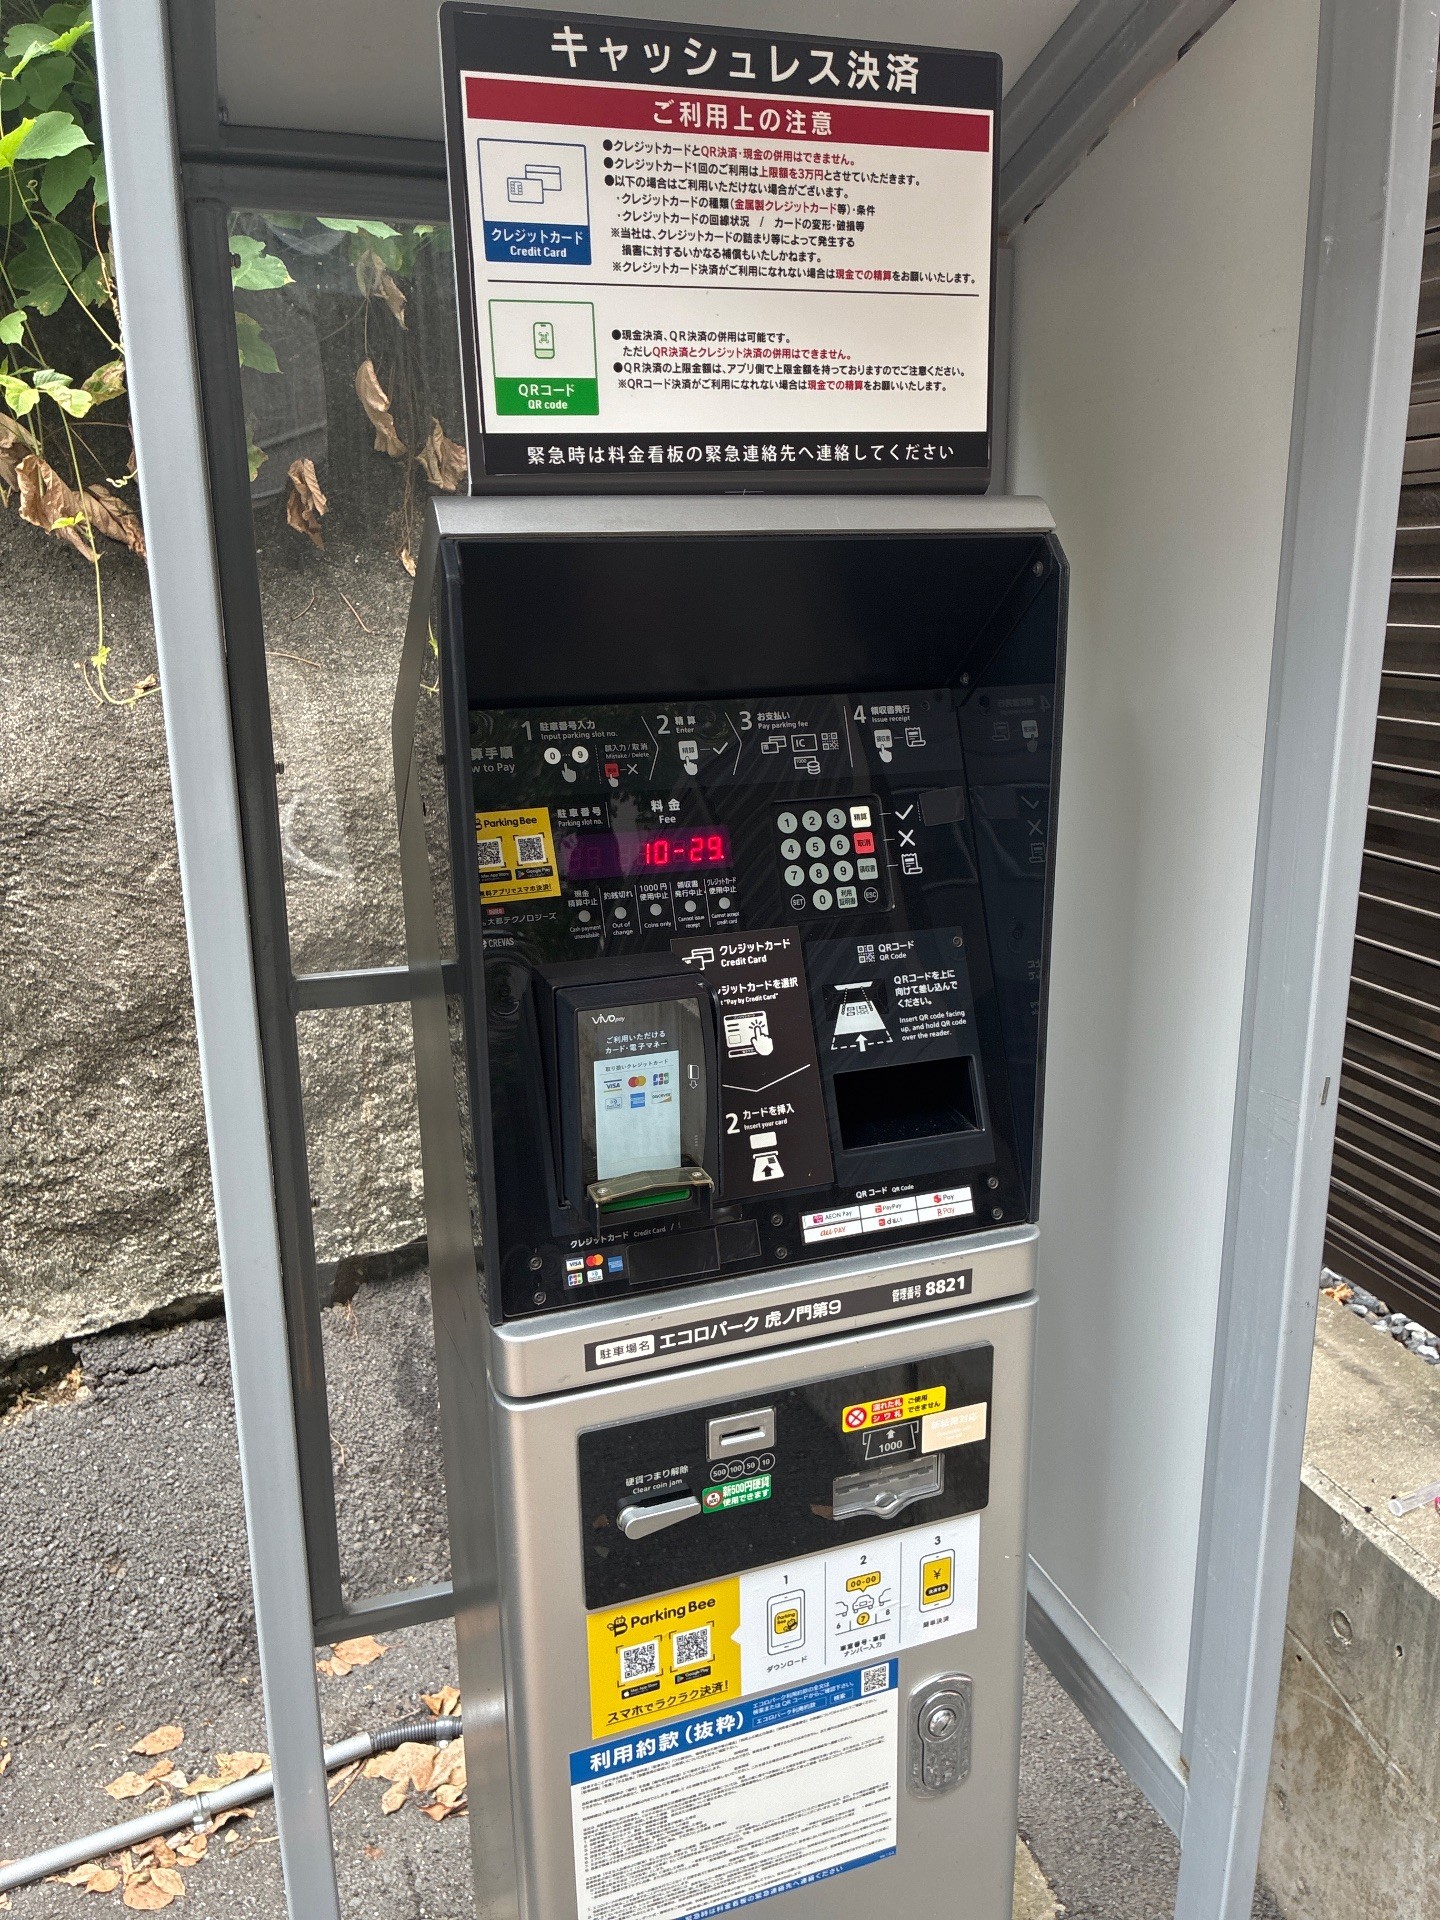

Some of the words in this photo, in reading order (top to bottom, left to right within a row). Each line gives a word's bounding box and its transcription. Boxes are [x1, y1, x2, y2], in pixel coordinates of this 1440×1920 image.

[551, 25, 920, 95] キャッシュレス決済
[653, 99, 833, 137] ご利用上の注意
[614, 174, 849, 199] 以下の場合はご利用いただけない場合がございます。
[774, 217, 866, 233] カードの変形・破損等
[490, 226, 584, 247] クレジットカード
[510, 246, 541, 259] Credit
[543, 247, 567, 260] Card
[622, 243, 822, 263] 損害に対するいかなる補償もいたしかねます。
[518, 383, 576, 398] QRコード
[528, 399, 542, 412] QR
[544, 399, 569, 411] code
[527, 443, 955, 466] 緊急時は料金看板の緊急連絡先へ連絡してください
[674, 715, 697, 726] 精算
[739, 710, 753, 731] 3
[757, 711, 791, 722] お支払い
[853, 704, 867, 724] 4
[521, 720, 532, 741] 1
[539, 720, 596, 732] 駐車番号入力
[656, 714, 671, 735] 2
[675, 726, 695, 735] Enter
[758, 722, 770, 730] Pay
[771, 721, 796, 730] parking
[798, 720, 809, 728] fee
[541, 733, 562, 741] Input
[563, 731, 589, 741] parking
[591, 730, 604, 738] slot
[796, 738, 806, 748] IC
[483, 764, 495, 773] to
[497, 763, 516, 774] Pay
[557, 807, 602, 819] 駐車番号
[651, 798, 681, 813] 料金
[483, 818, 519, 828] Parking
[519, 816, 538, 826] Bee
[558, 820, 581, 828] Parking
[659, 815, 677, 824] Fee
[784, 818, 790, 828] 1
[809, 816, 816, 826] 2
[833, 814, 840, 823] 3
[853, 812, 868, 821] 精算
[787, 844, 794, 854] 4
[812, 842, 819, 852] 5
[836, 840, 844, 850] 6
[790, 870, 798, 881] 7
[815, 868, 823, 879] 8
[840, 865, 847, 876] 9
[573, 889, 590, 899] 現金
[819, 894, 826, 905] 0
[581, 924, 601, 932] payment
[613, 928, 634, 936] change
[644, 921, 656, 929] Coins
[657, 920, 672, 928] only
[488, 937, 515, 948] CREVAS
[719, 938, 791, 956] クレジットカード
[878, 940, 915, 953] QRコード
[720, 957, 747, 968] Credit
[747, 955, 767, 965] Card
[879, 954, 889, 962] QR
[890, 952, 907, 960] Code
[893, 969, 956, 985] QRコードを上に
[894, 981, 958, 997] 向けて差し込んで
[745, 995, 762, 1003] Credit
[897, 997, 933, 1008] ください。
[899, 1015, 918, 1024] Insert
[919, 1014, 929, 1022] QR
[929, 1012, 945, 1020] code
[945, 1009, 966, 1018] facing
[940, 1019, 951, 1027] QR
[951, 1018, 967, 1026] code
[606, 1030, 666, 1045] ご利用いただける
[929, 1029, 952, 1038] reader.
[605, 1040, 668, 1055] カード・電子マネー
[742, 1103, 795, 1120] カードを挿入
[725, 1113, 741, 1135] 2
[743, 1121, 760, 1131] Insert
[760, 1120, 775, 1130] your
[775, 1117, 788, 1127] card
[824, 1212, 842, 1221] AEON
[882, 1202, 903, 1212] PayPay
[942, 1193, 955, 1202] Pay
[570, 1230, 629, 1249] クレジットカード
[633, 1229, 652, 1238] Credit
[652, 1226, 666, 1235] Card
[599, 1339, 652, 1362] 駐車場名
[659, 1314, 759, 1350] エコロパーク
[764, 1300, 842, 1330] 虎ノ門第9
[891, 1285, 922, 1304] 管理番号
[925, 1276, 967, 1297] 8821
[908, 1394, 929, 1404] ご使用
[908, 1400, 941, 1413] できません
[878, 1440, 903, 1453] 1000
[713, 1468, 727, 1476] 500
[729, 1465, 742, 1473] 100
[746, 1462, 756, 1470] 50
[762, 1458, 771, 1466] 10
[625, 1465, 689, 1487] 硬貨つまり解除
[632, 1485, 652, 1495] Clear
[653, 1481, 668, 1490] coin
[669, 1478, 683, 1488] jam
[722, 1476, 770, 1498] 新500円硬貨
[722, 1489, 770, 1508] 使用できます
[783, 1574, 789, 1585] 1
[859, 1555, 867, 1566] 2
[934, 1535, 942, 1546] 3
[850, 1574, 877, 1588] 00-00
[630, 1604, 686, 1628] Parking
[688, 1598, 717, 1614] Bee
[844, 1642, 882, 1657] ナンバー入力
[767, 1656, 808, 1674] ダウンロード
[607, 1680, 729, 1724] スマホでラクラク決済!
